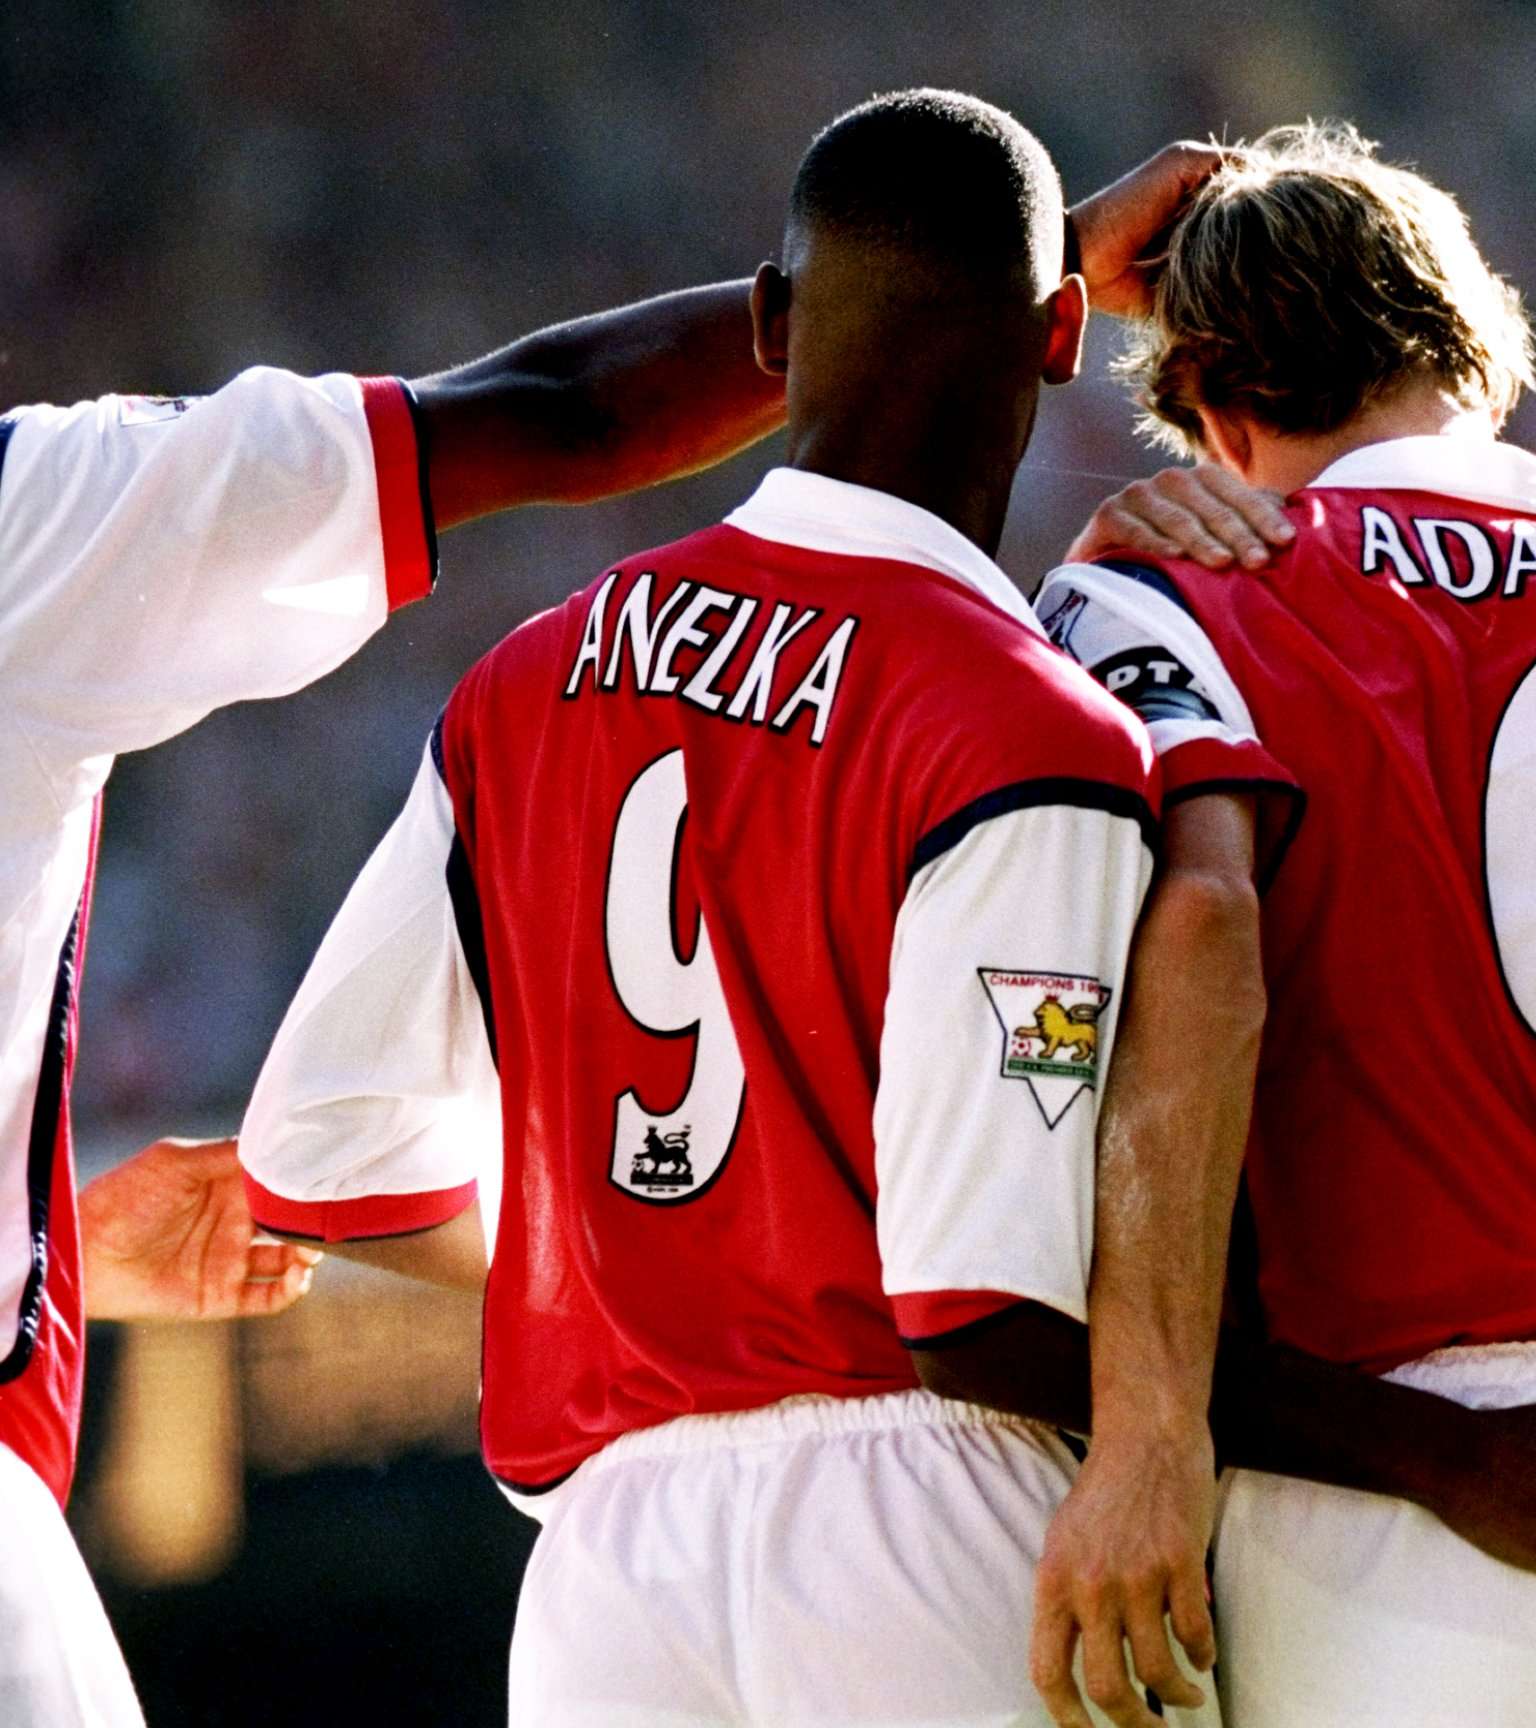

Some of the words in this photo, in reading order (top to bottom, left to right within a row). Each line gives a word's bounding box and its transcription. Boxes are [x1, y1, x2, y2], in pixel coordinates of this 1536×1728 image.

[563, 566, 859, 746] ANELKA
[605, 747, 747, 1204] 9
[990, 973, 1074, 991] CHAMPIONS
